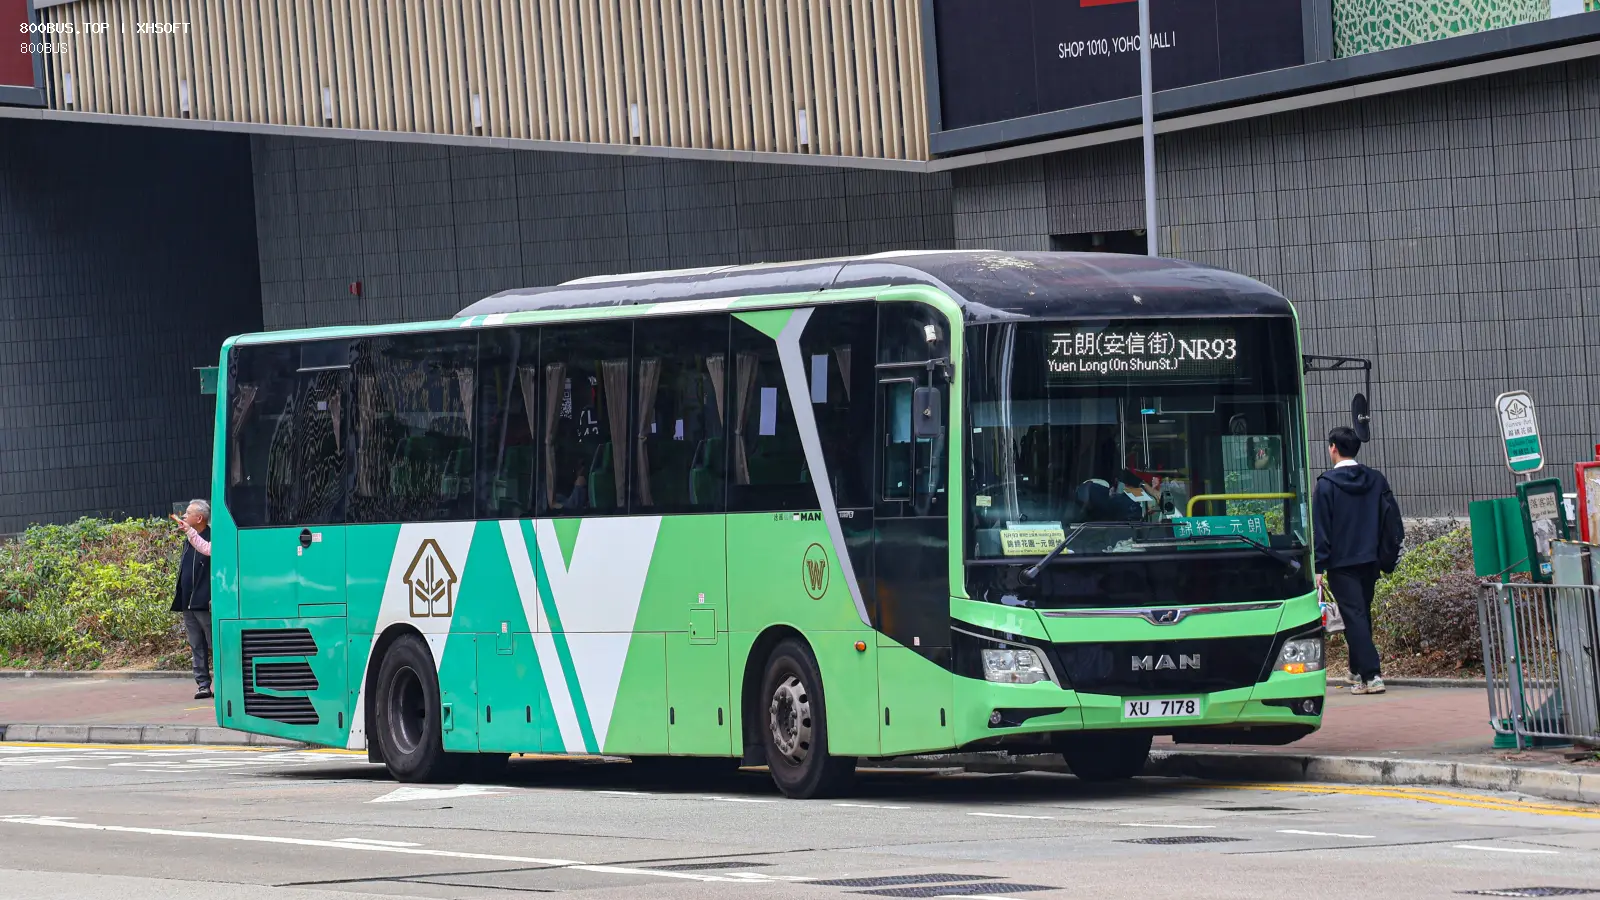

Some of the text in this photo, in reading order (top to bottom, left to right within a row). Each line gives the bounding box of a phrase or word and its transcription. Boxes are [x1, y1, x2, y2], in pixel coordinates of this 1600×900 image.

[1058, 41, 1085, 59] SHOP
[1086, 38, 1111, 57] 1010,
[1112, 34, 1141, 53] YOHO
[1051, 331, 1176, 357] 元朗(安信街)
[1177, 337, 1238, 361] NR93
[1047, 359, 1077, 373] Yuen
[800, 512, 822, 522] MAN
[806, 558, 826, 591] W
[1131, 653, 1201, 671] MAN
[1129, 700, 1195, 717] XU 7178
